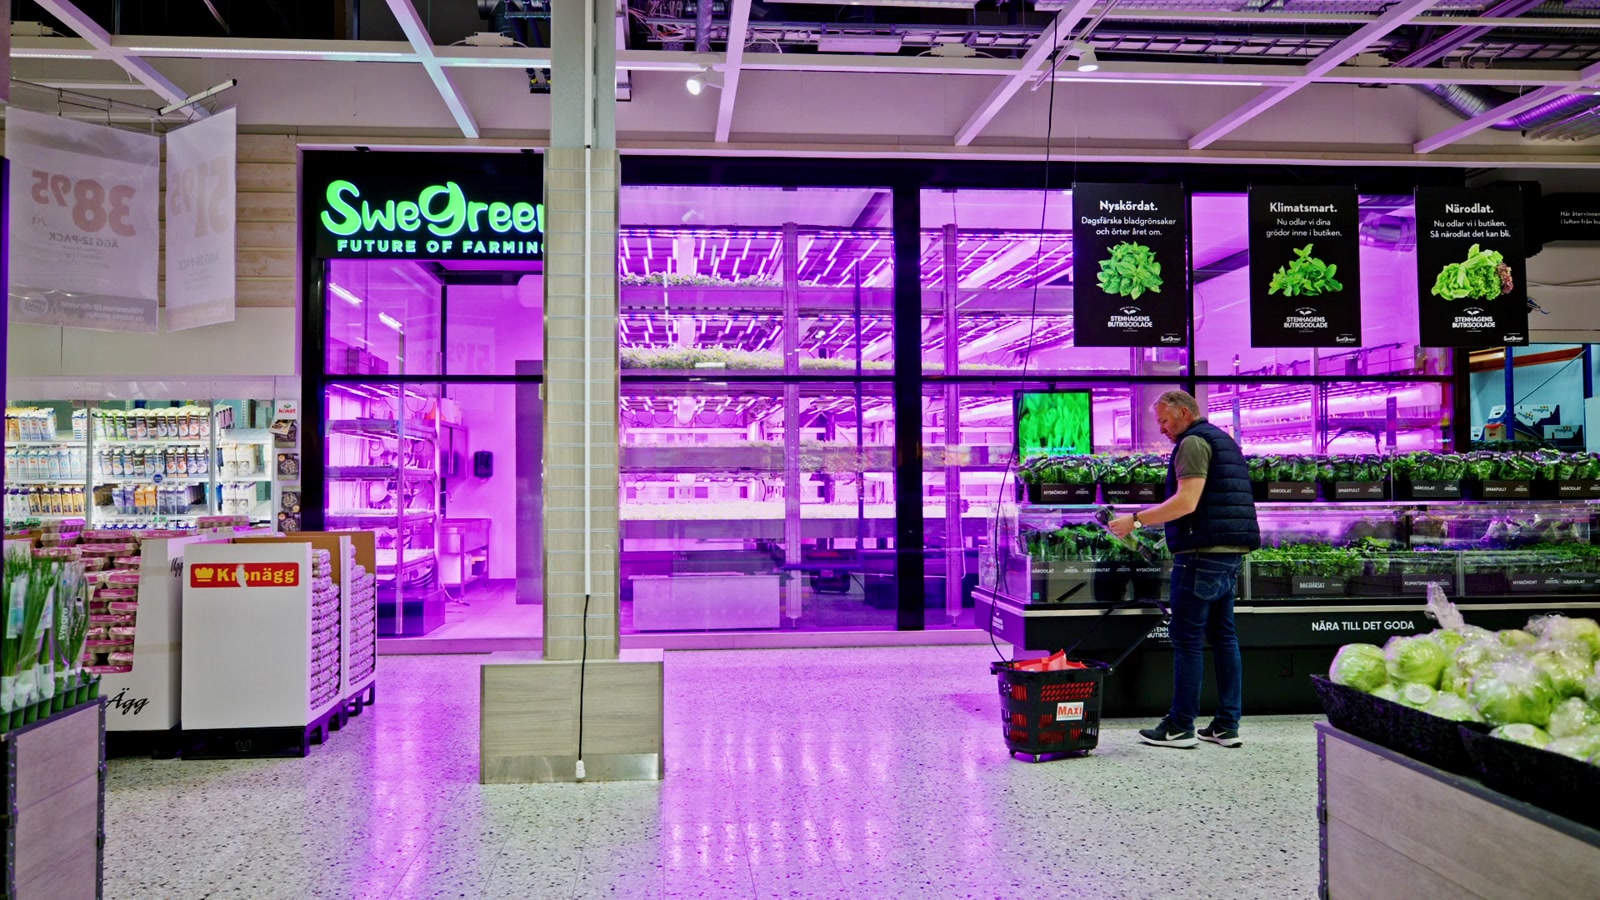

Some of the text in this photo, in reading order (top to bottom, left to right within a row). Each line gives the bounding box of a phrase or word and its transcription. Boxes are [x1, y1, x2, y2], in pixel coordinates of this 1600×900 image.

[1100, 200, 1158, 213] Nyskördat.
[1270, 202, 1338, 212] Klimatsmart.
[1445, 203, 1494, 213] Närodlat.
[1081, 216, 1176, 226] Dagsfärska bladgrönsaker
[1096, 227, 1110, 235] och
[1132, 227, 1147, 235] året
[1266, 229, 1290, 238] grödor
[337, 240, 416, 252] FUTURE
[426, 240, 452, 252] OF
[1312, 620, 1415, 631] NÄRA TILL DET GODA
[105, 688, 150, 715] Ägg
